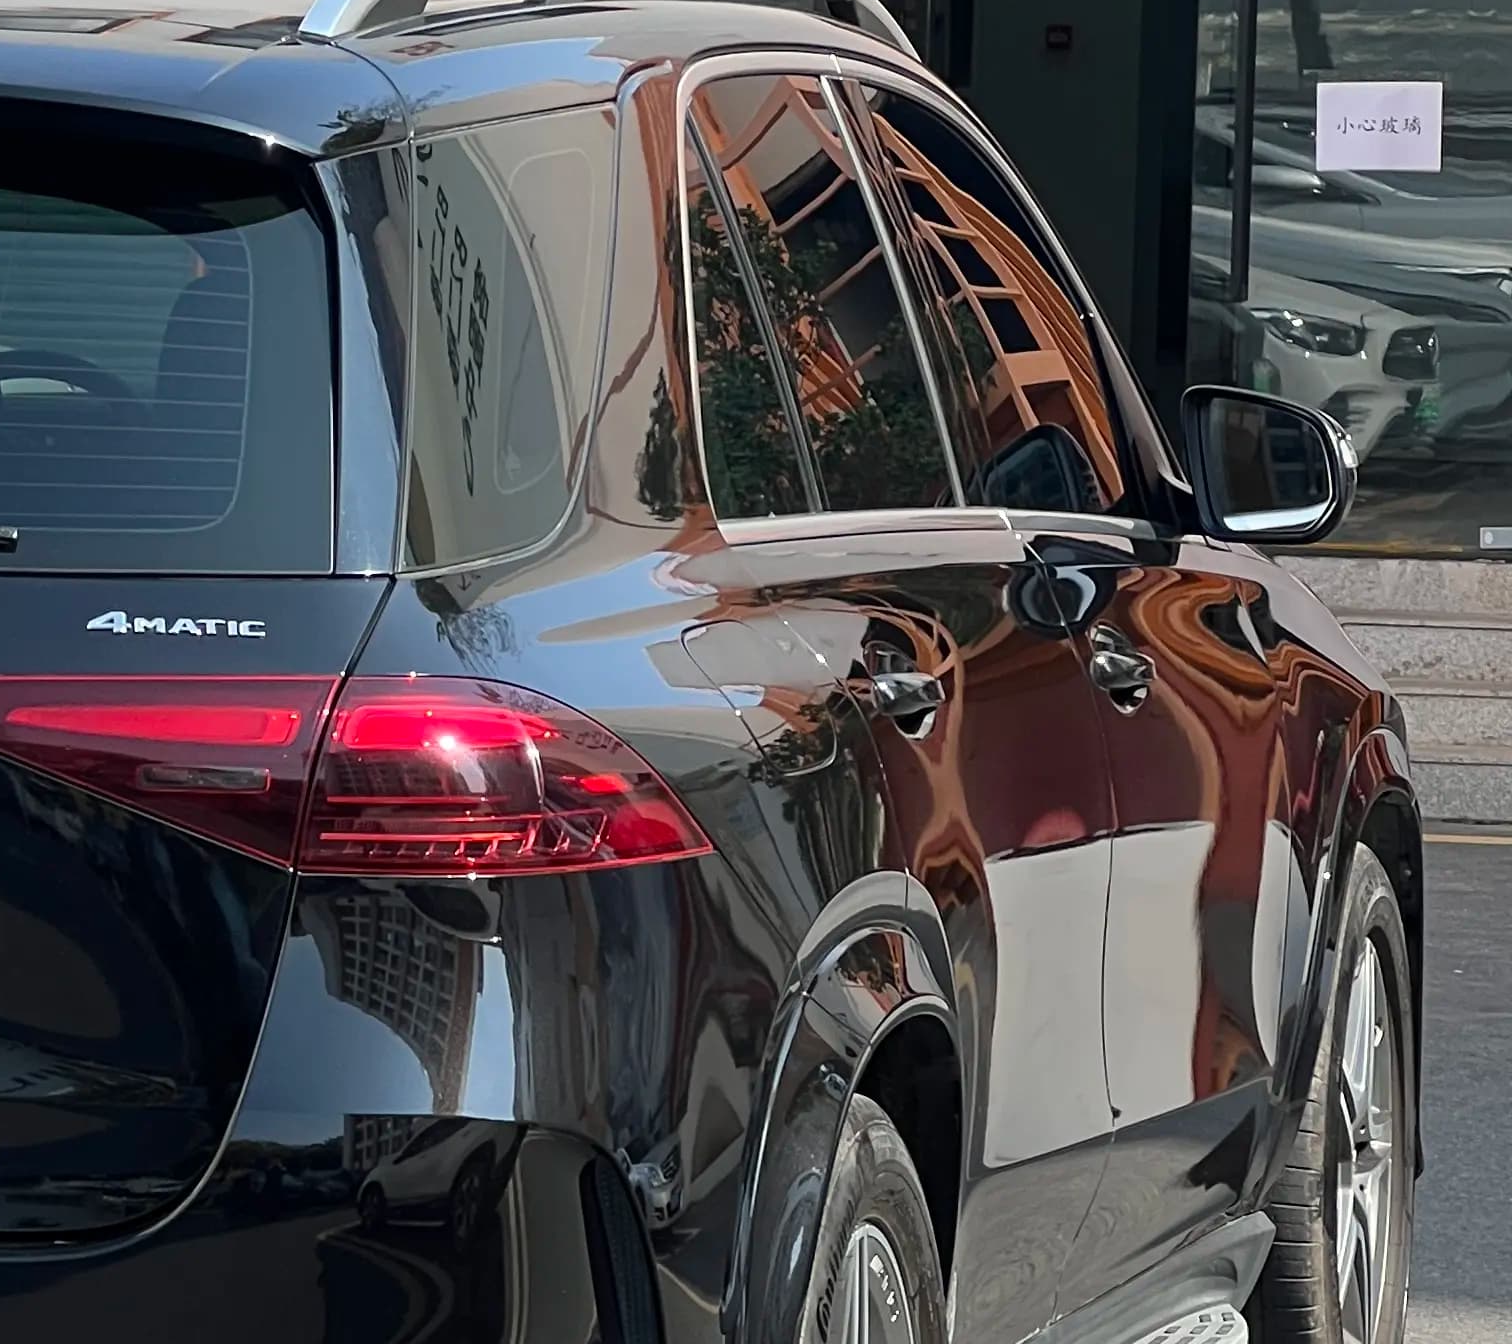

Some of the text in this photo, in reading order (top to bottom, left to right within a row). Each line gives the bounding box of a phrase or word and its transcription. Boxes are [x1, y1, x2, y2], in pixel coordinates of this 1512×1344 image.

[1337, 116, 1422, 136] 小心玻璃
[86, 610, 267, 637] 4MATIC
